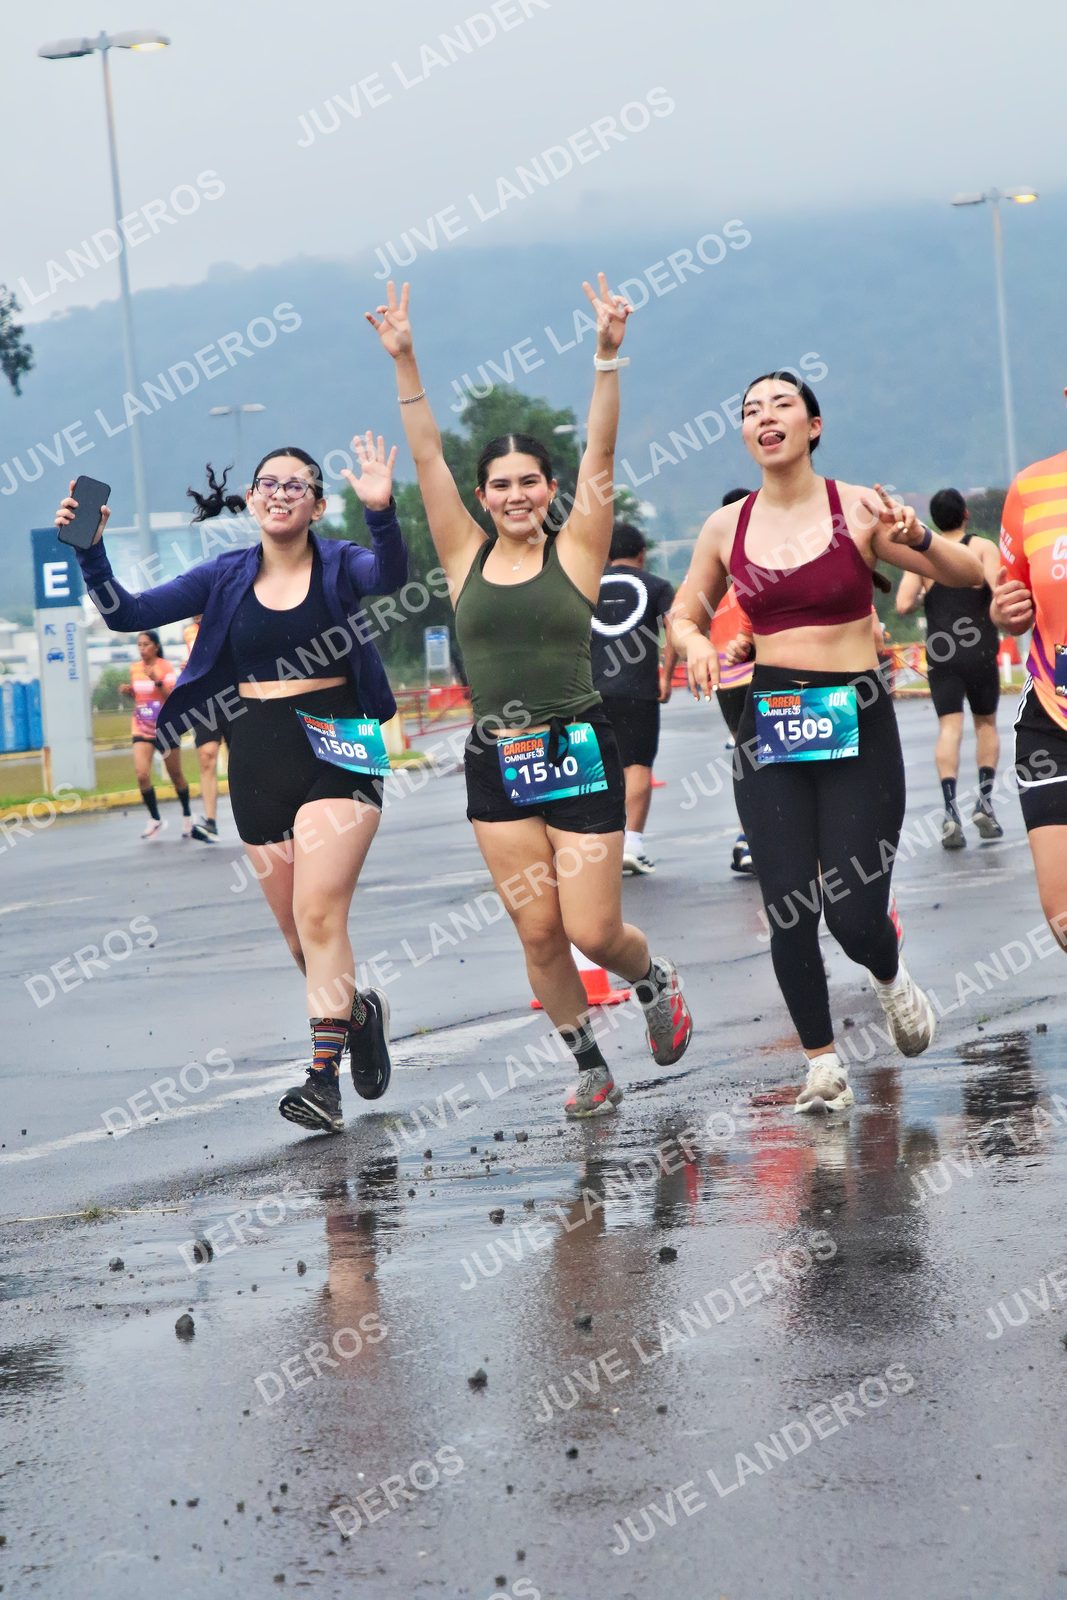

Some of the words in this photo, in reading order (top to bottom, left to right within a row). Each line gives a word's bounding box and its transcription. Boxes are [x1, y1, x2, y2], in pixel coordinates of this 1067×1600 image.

[43, 562, 70, 598] E
[65, 622, 78, 680] General
[829, 692, 848, 707] 10K
[357, 724, 374, 736] 10K
[569, 728, 588, 744] 10K
[774, 718, 833, 741] 1509
[320, 737, 368, 760] 1508
[503, 738, 543, 756] CARRERA
